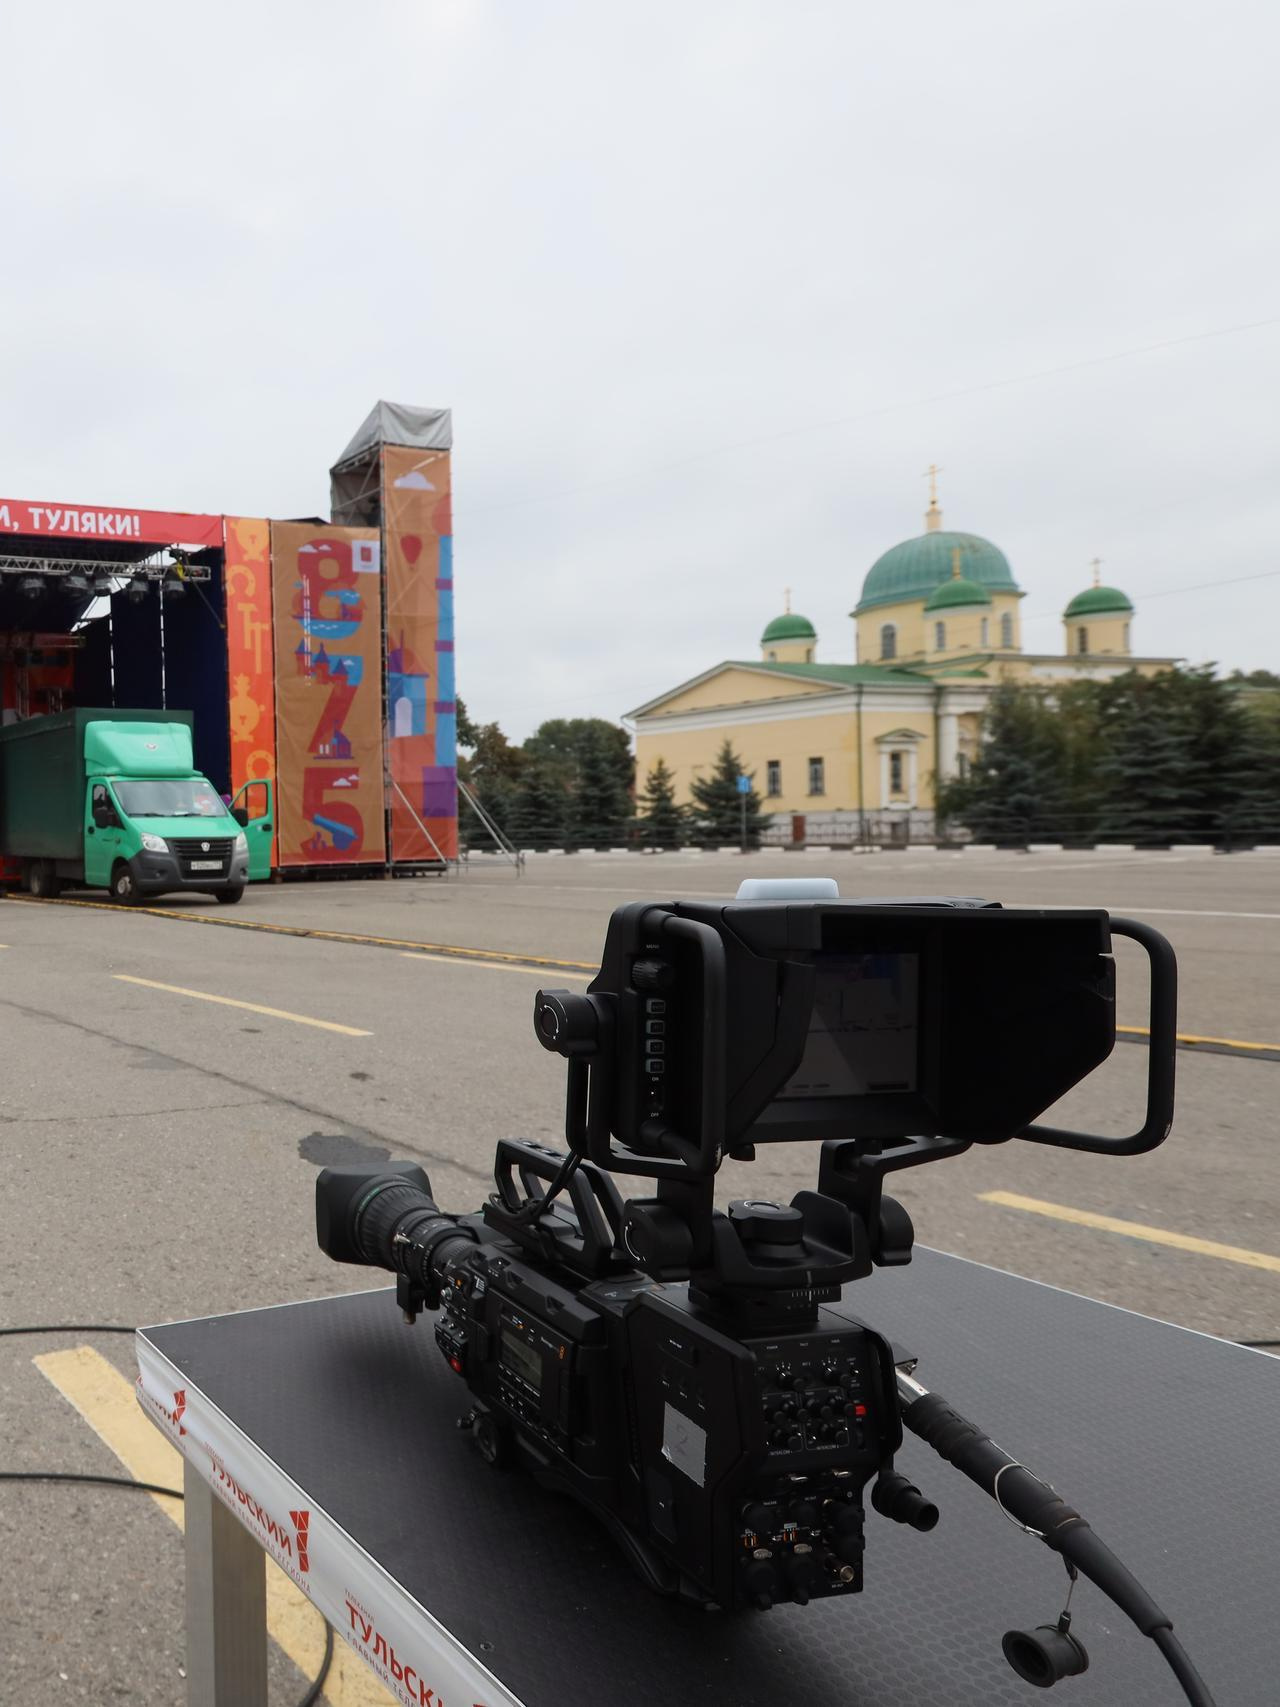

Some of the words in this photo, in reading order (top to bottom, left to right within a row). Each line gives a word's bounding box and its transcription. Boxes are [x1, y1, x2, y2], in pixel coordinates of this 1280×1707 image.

[28, 507, 140, 537] ТУЛЯКИ!
[345, 1600, 443, 1707] ТУЛЬСК
[392, 1682, 416, 1707] ТЕЛ
